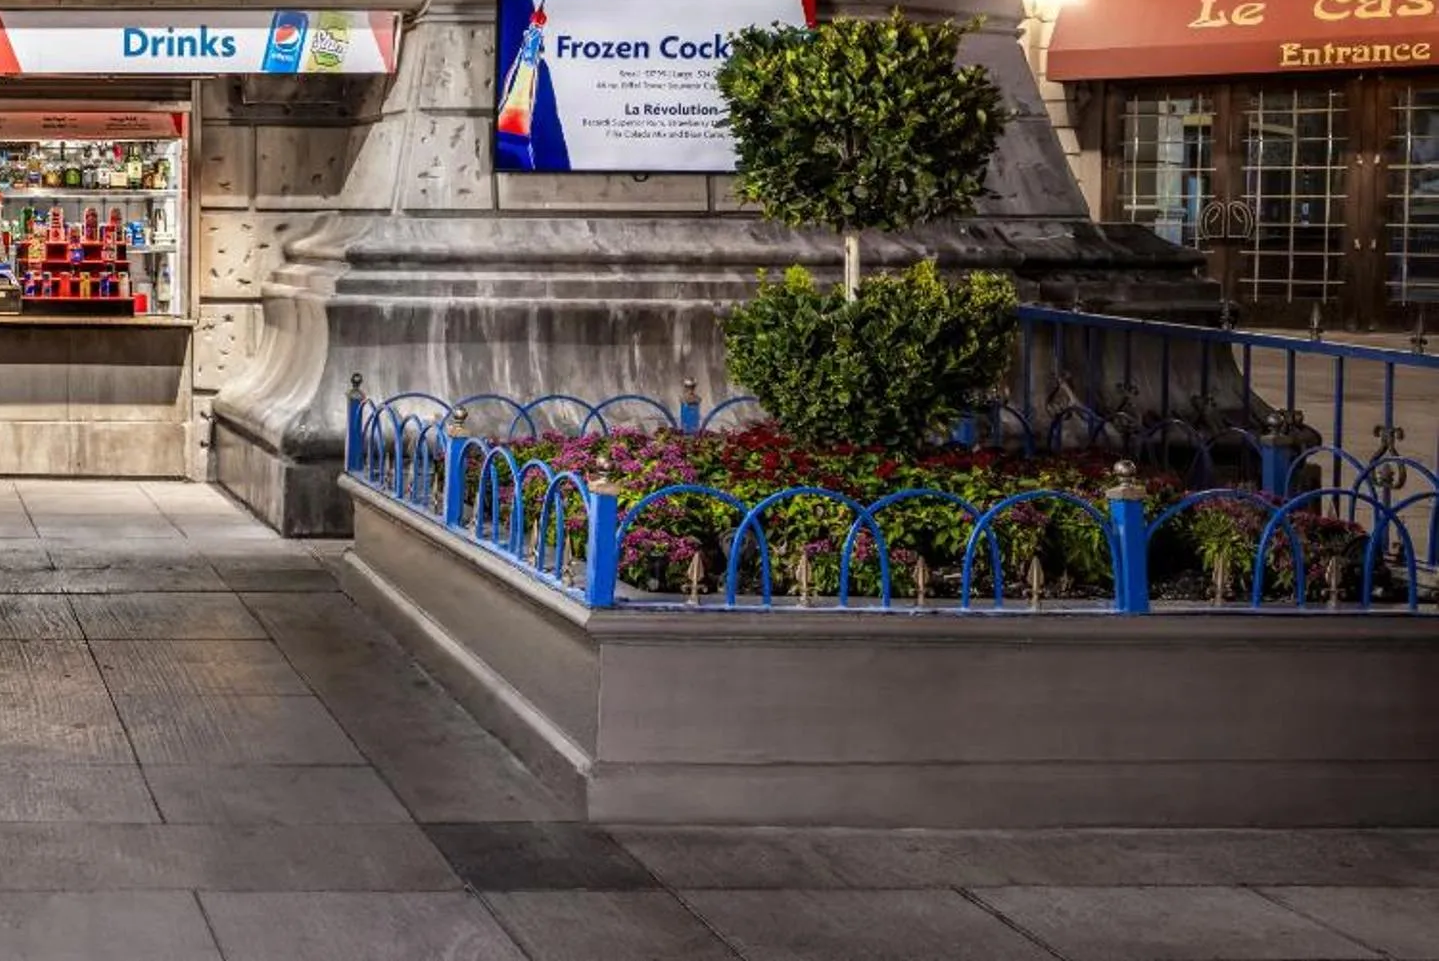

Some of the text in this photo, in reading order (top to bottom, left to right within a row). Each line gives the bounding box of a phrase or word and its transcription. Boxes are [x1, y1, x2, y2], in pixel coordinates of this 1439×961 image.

[123, 24, 237, 58] Drinks
[556, 34, 730, 60] Frozen Cock
[1279, 42, 1431, 67] Entrance
[625, 103, 719, 116] La Révolution
